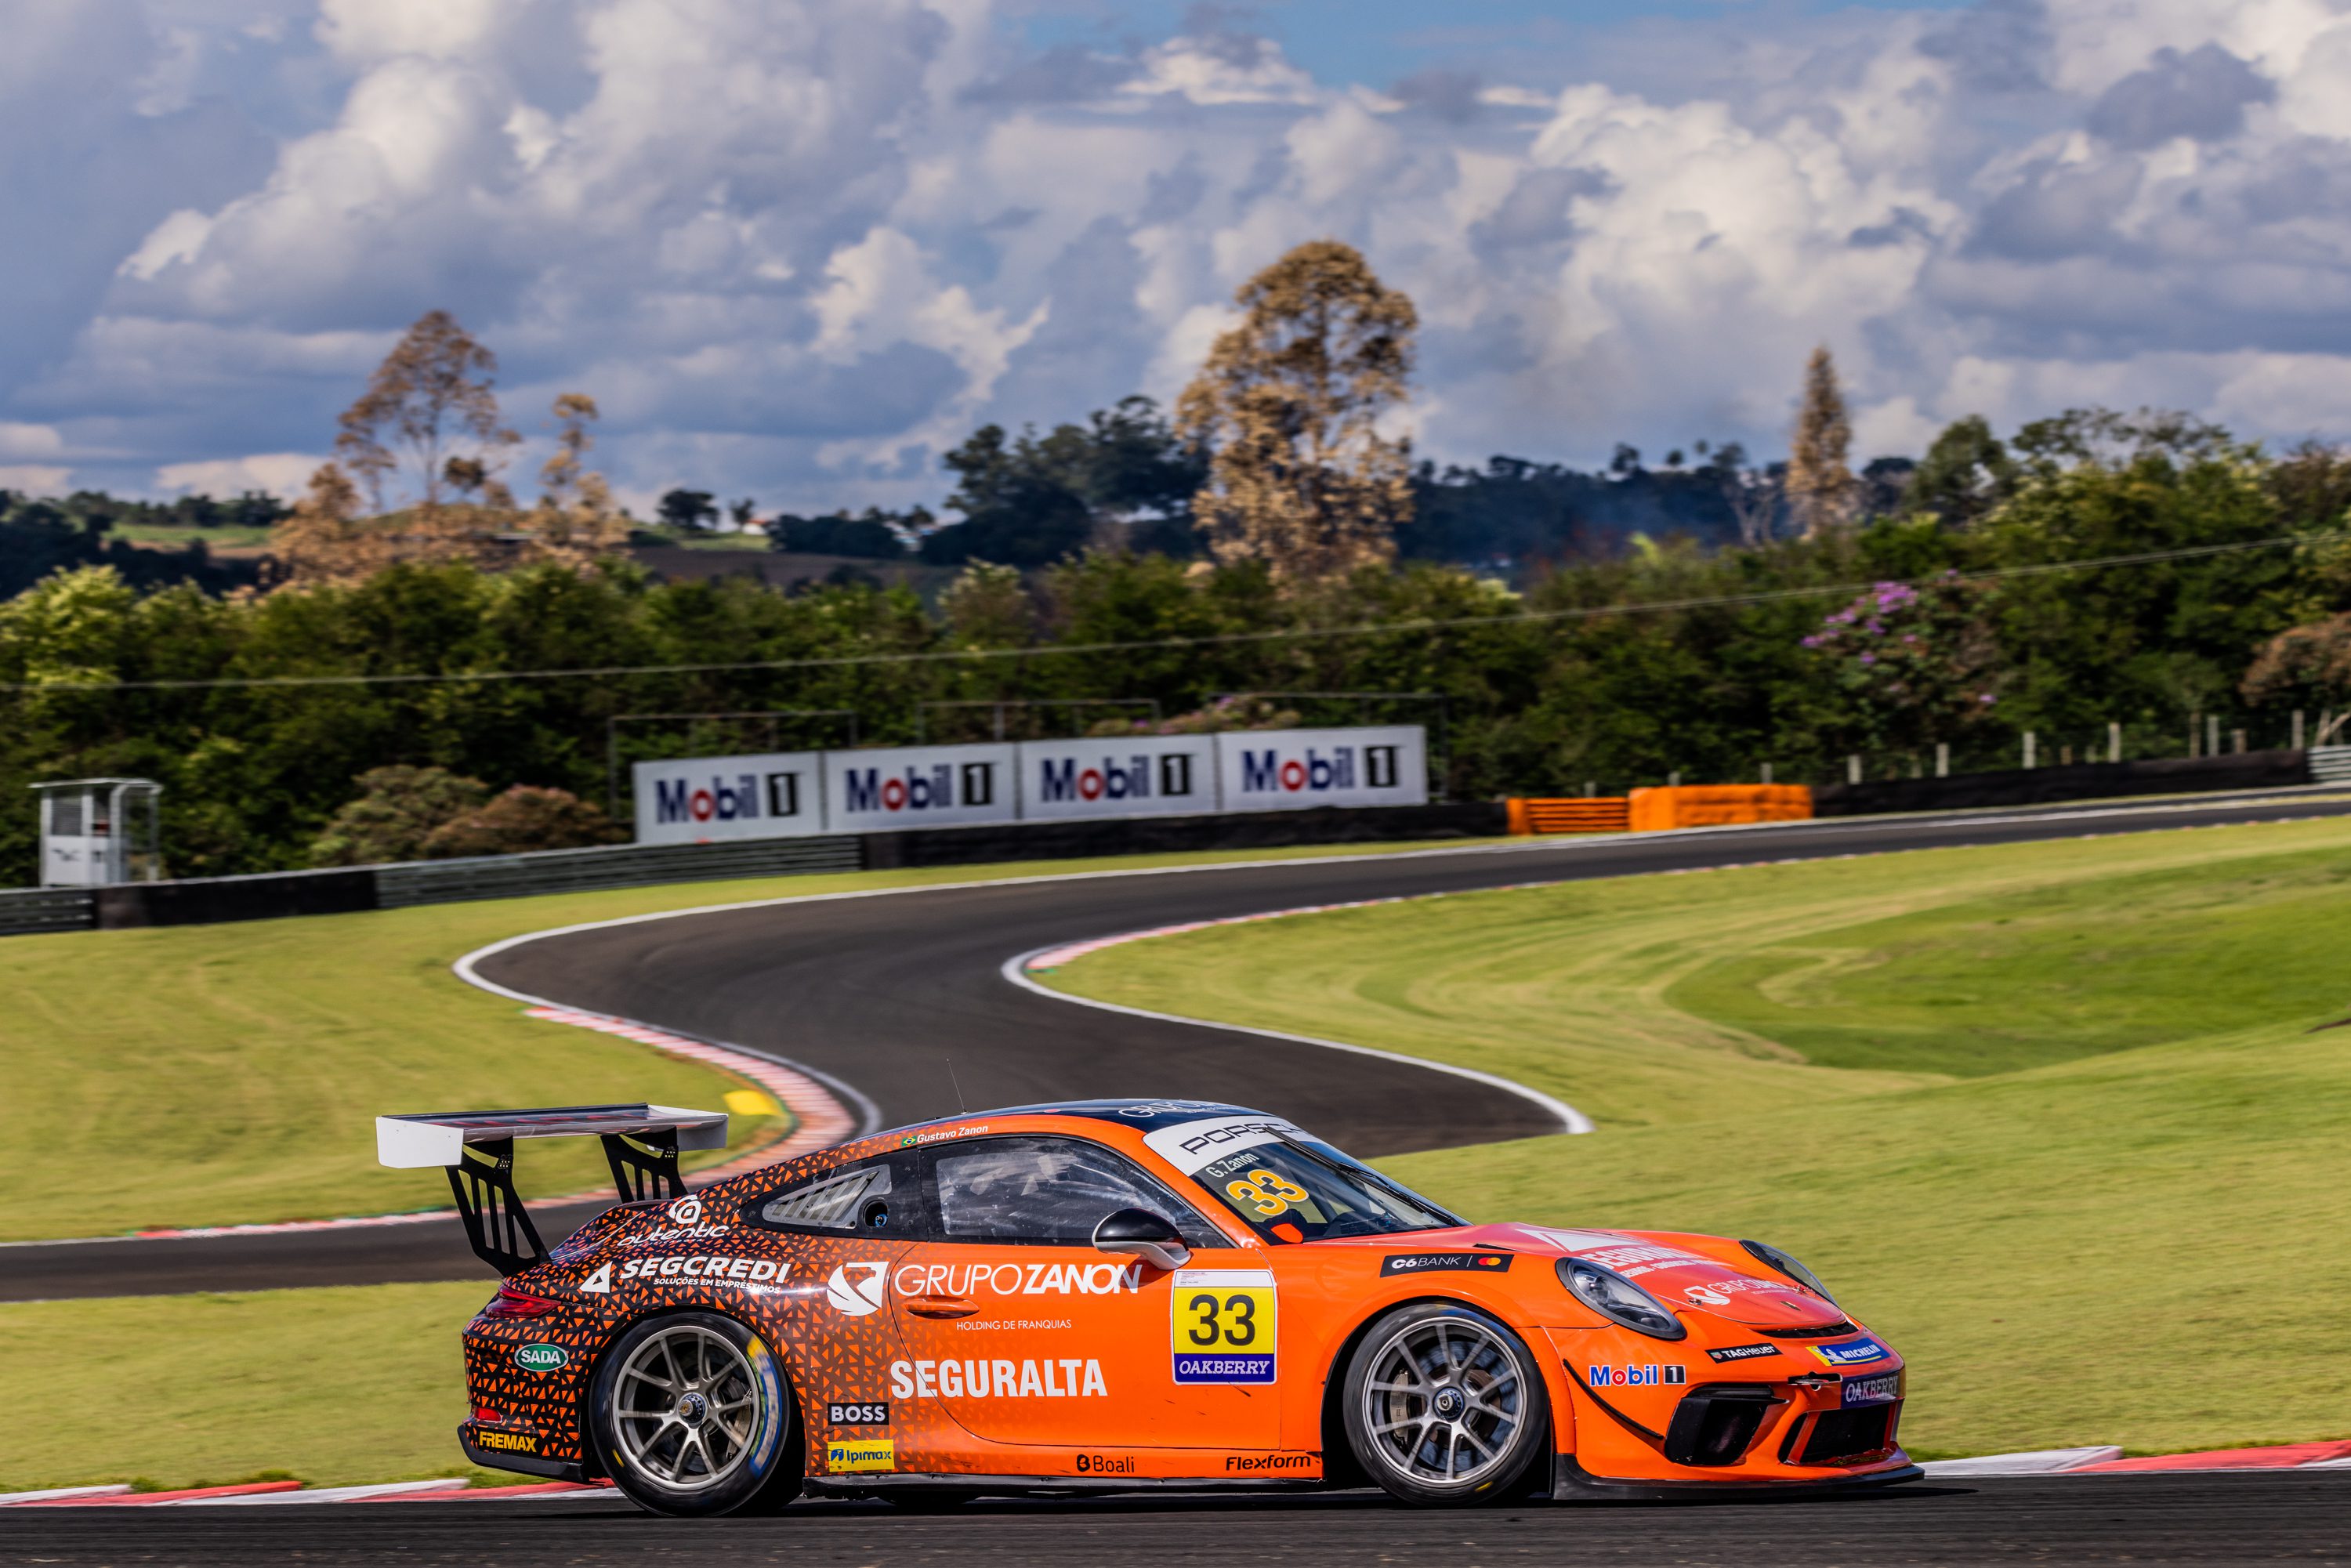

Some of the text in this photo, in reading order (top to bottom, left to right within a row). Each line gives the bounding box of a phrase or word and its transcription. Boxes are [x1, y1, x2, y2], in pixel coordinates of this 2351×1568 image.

[1041, 755, 1150, 802] Mobil
[1241, 747, 1353, 791] Mobil
[657, 773, 759, 824] Mobil
[846, 763, 952, 812] Mobil
[917, 1124, 988, 1143] Gustavo Zanon
[1205, 1153, 1259, 1178] G. Zanon
[1226, 1168, 1309, 1215] 33
[620, 1256, 791, 1284] SEGCREDI
[653, 1276, 699, 1285] SOLUÇÕES
[715, 1279, 781, 1295] EMPRÉSTIMOS
[956, 1319, 1072, 1331] HOLDING DE FRANQUIAS
[1188, 1295, 1255, 1345] 33
[520, 1349, 561, 1364] SADA
[1840, 1344, 1881, 1359] MICHELIN
[1179, 1360, 1270, 1374] OAKBERRY
[1589, 1364, 1658, 1386] Mobil
[890, 1359, 1108, 1399] SEGURALTA
[1845, 1376, 1898, 1402] OAKBERRY
[831, 1406, 886, 1421] BOSS
[479, 1432, 537, 1453] FREMAX
[1093, 1455, 1134, 1472] Boali
[1226, 1454, 1310, 1471] Flexform
